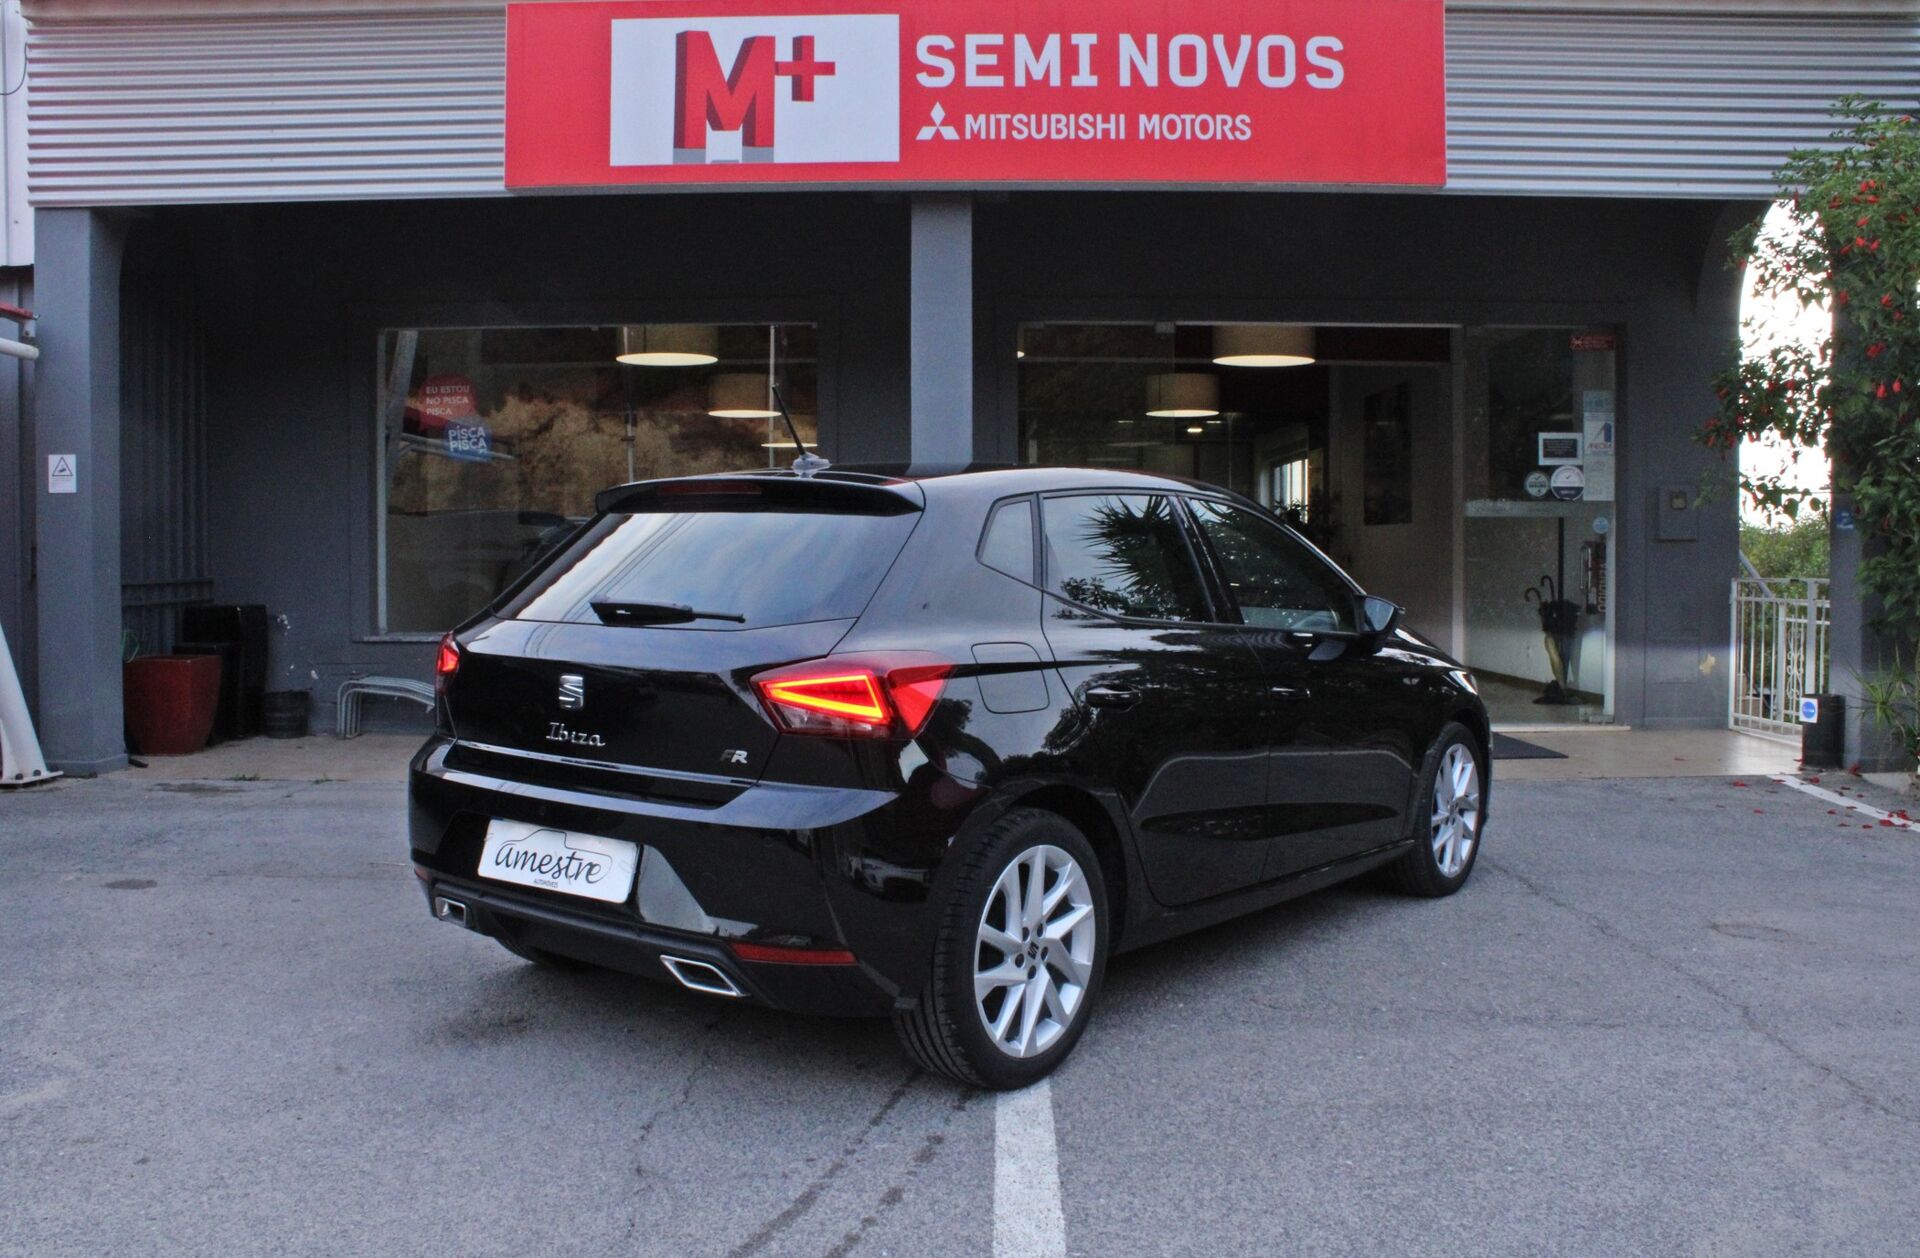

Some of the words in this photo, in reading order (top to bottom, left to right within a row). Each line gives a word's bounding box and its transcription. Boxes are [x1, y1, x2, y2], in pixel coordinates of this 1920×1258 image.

[915, 33, 1099, 88] SEMI
[1118, 33, 1345, 89] NOVOS
[964, 113, 1126, 141] MITSUBISHI
[1138, 113, 1252, 141] MOTORS
[427, 386, 438, 394] EU
[440, 385, 470, 393] ESTOU
[426, 397, 441, 405] NO
[450, 438, 487, 451] PISCA
[546, 721, 606, 746] Ibiza
[720, 749, 748, 764] FR
[495, 842, 602, 884] amestre
